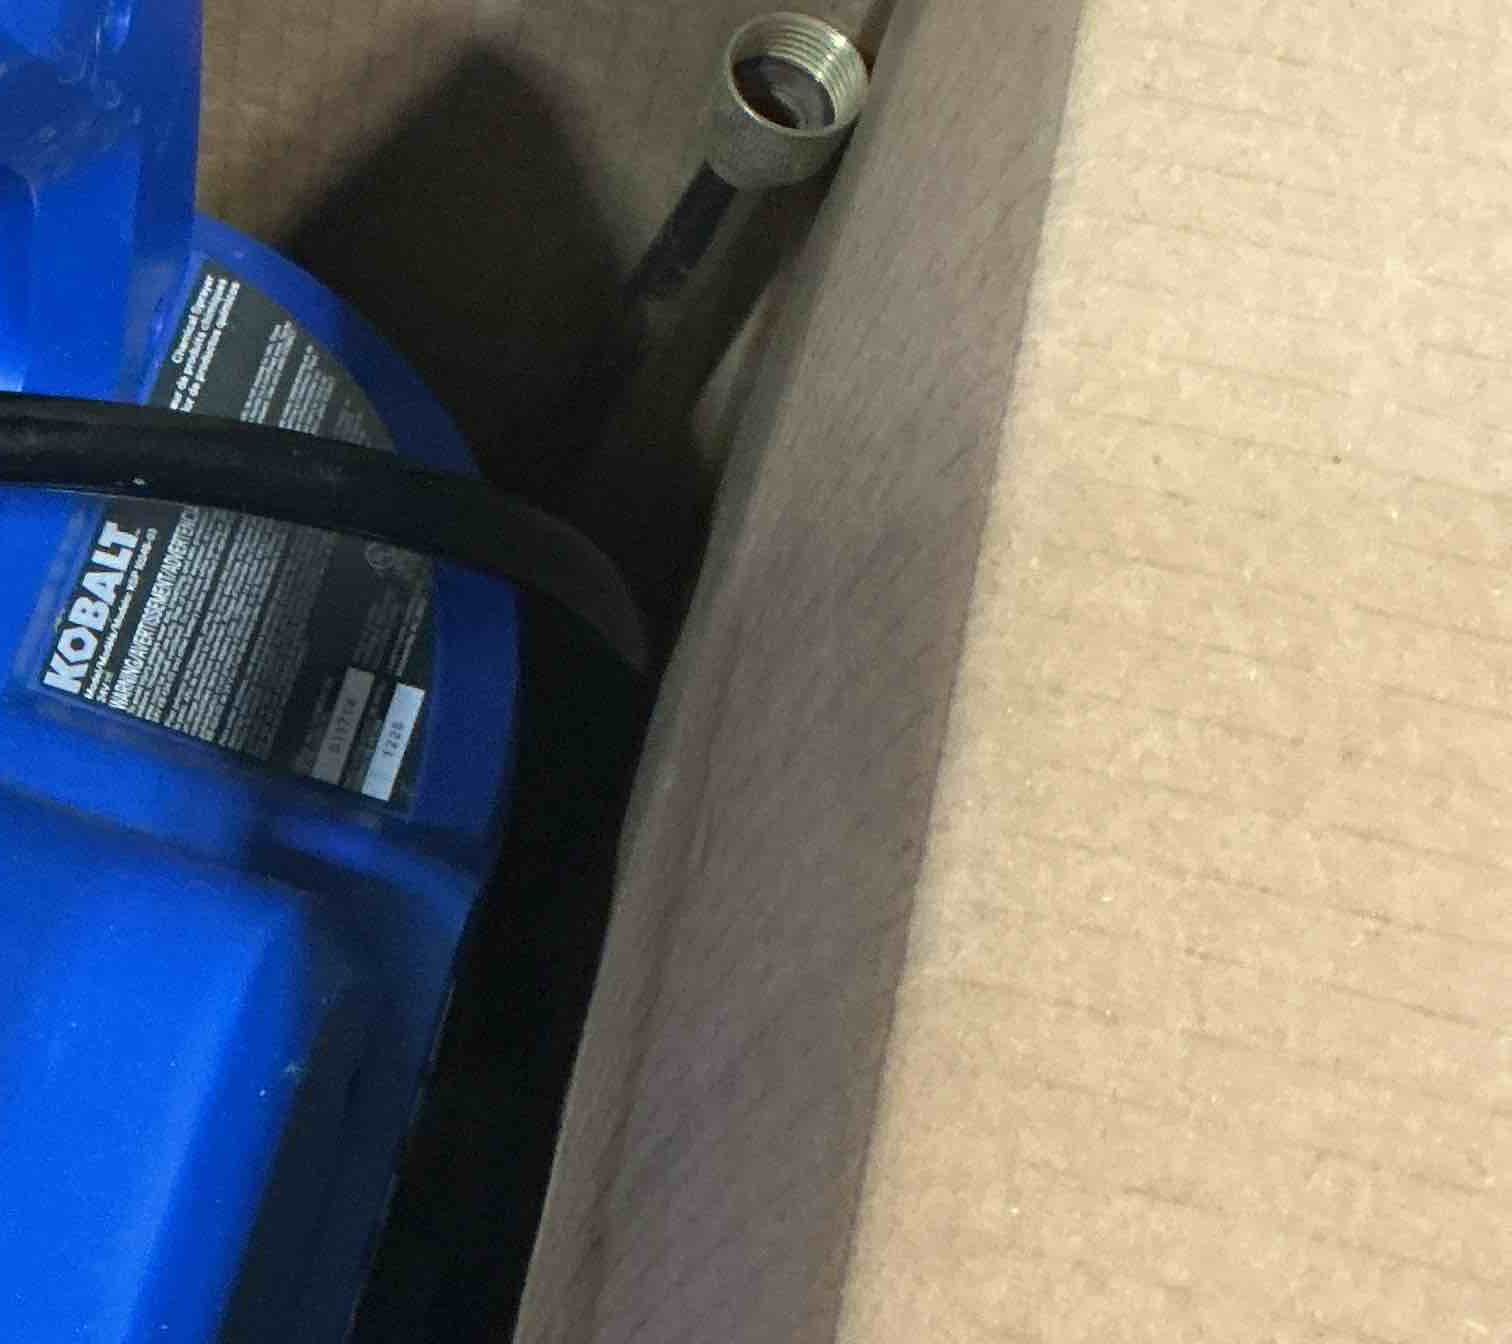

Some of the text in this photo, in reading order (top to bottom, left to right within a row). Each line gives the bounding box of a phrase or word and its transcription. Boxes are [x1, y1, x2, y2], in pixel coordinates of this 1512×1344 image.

[172, 273, 216, 363] Chemical Sprayer
[176, 375, 189, 390] de
[183, 330, 207, 376] produits
[201, 278, 229, 331] chimiques
[188, 381, 200, 397] de
[195, 329, 222, 382] productos
[43, 519, 140, 693] KOBALT
